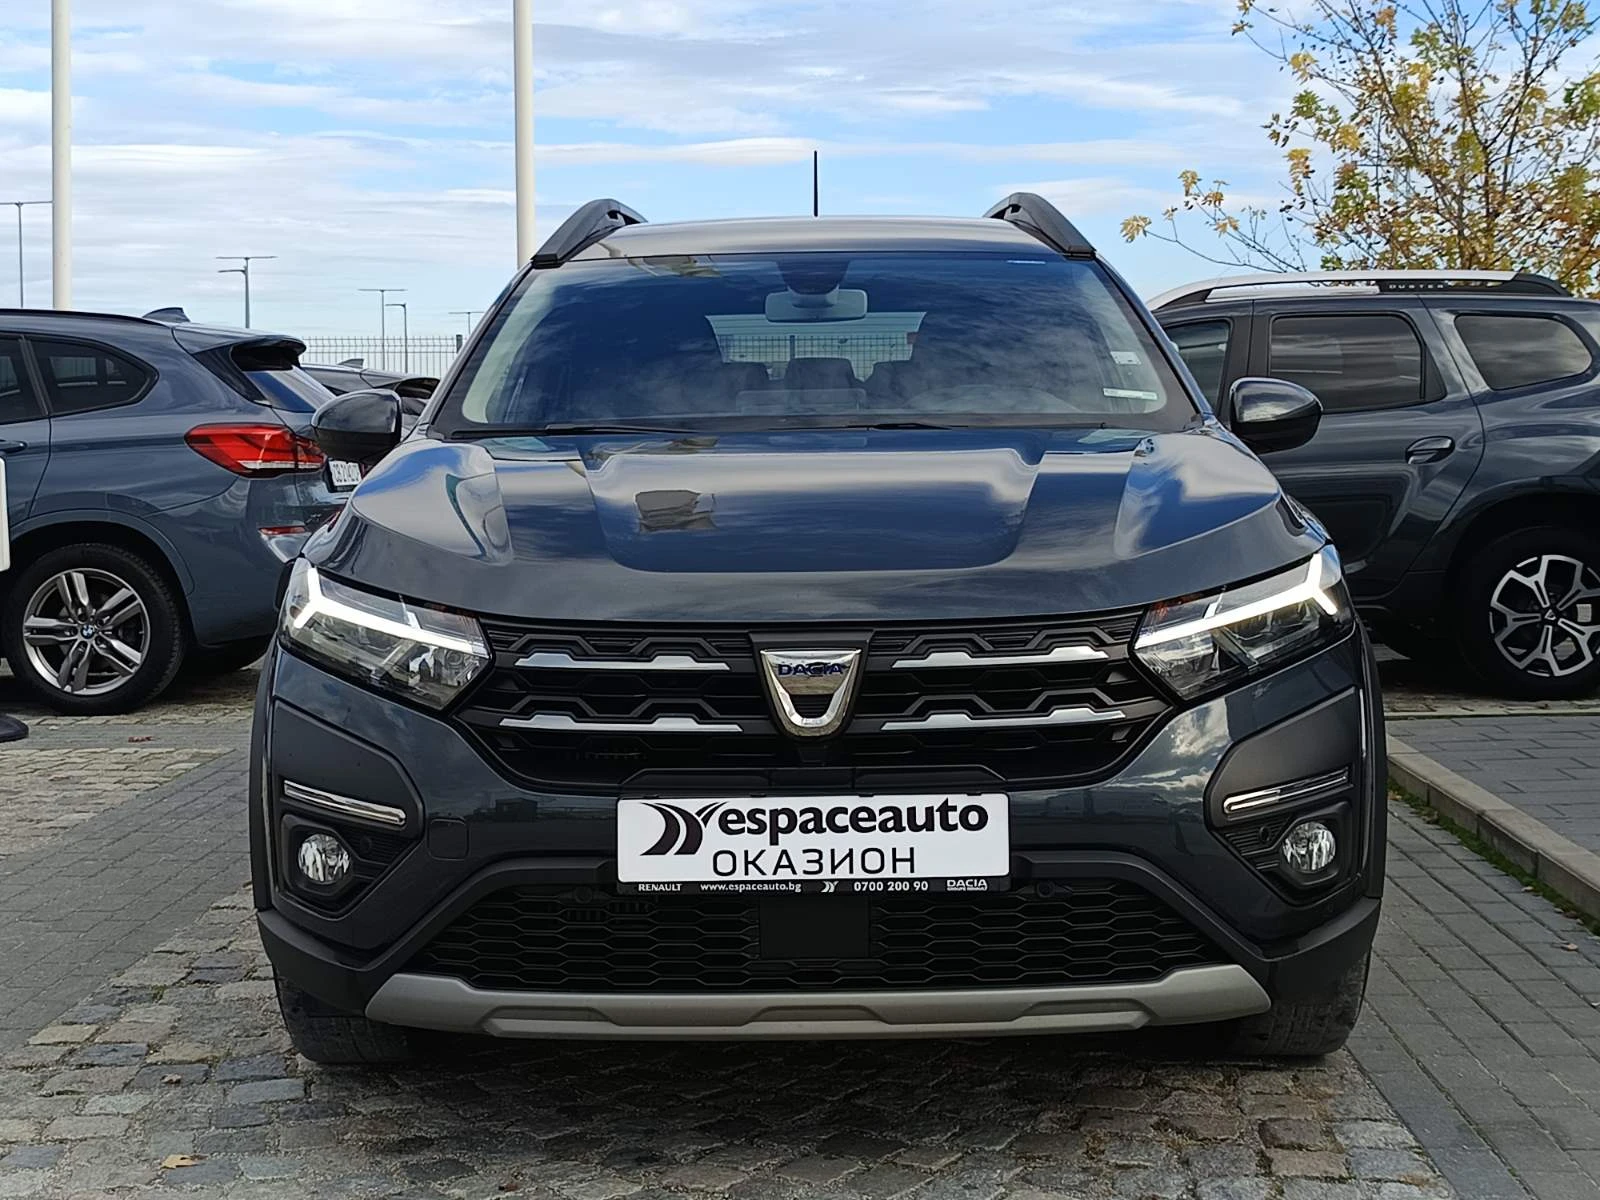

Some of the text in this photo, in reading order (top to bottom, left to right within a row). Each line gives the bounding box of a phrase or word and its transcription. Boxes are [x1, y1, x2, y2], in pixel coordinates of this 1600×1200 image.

[778, 663, 843, 675] DACIA
[718, 797, 989, 846] espaceauto
[712, 847, 915, 877] ОКАЗИОН
[637, 883, 682, 892] RENAULT
[700, 882, 802, 892] www.espaceauto.bg
[854, 881, 928, 891] 0700 200 90
[947, 879, 987, 887] DACIA
